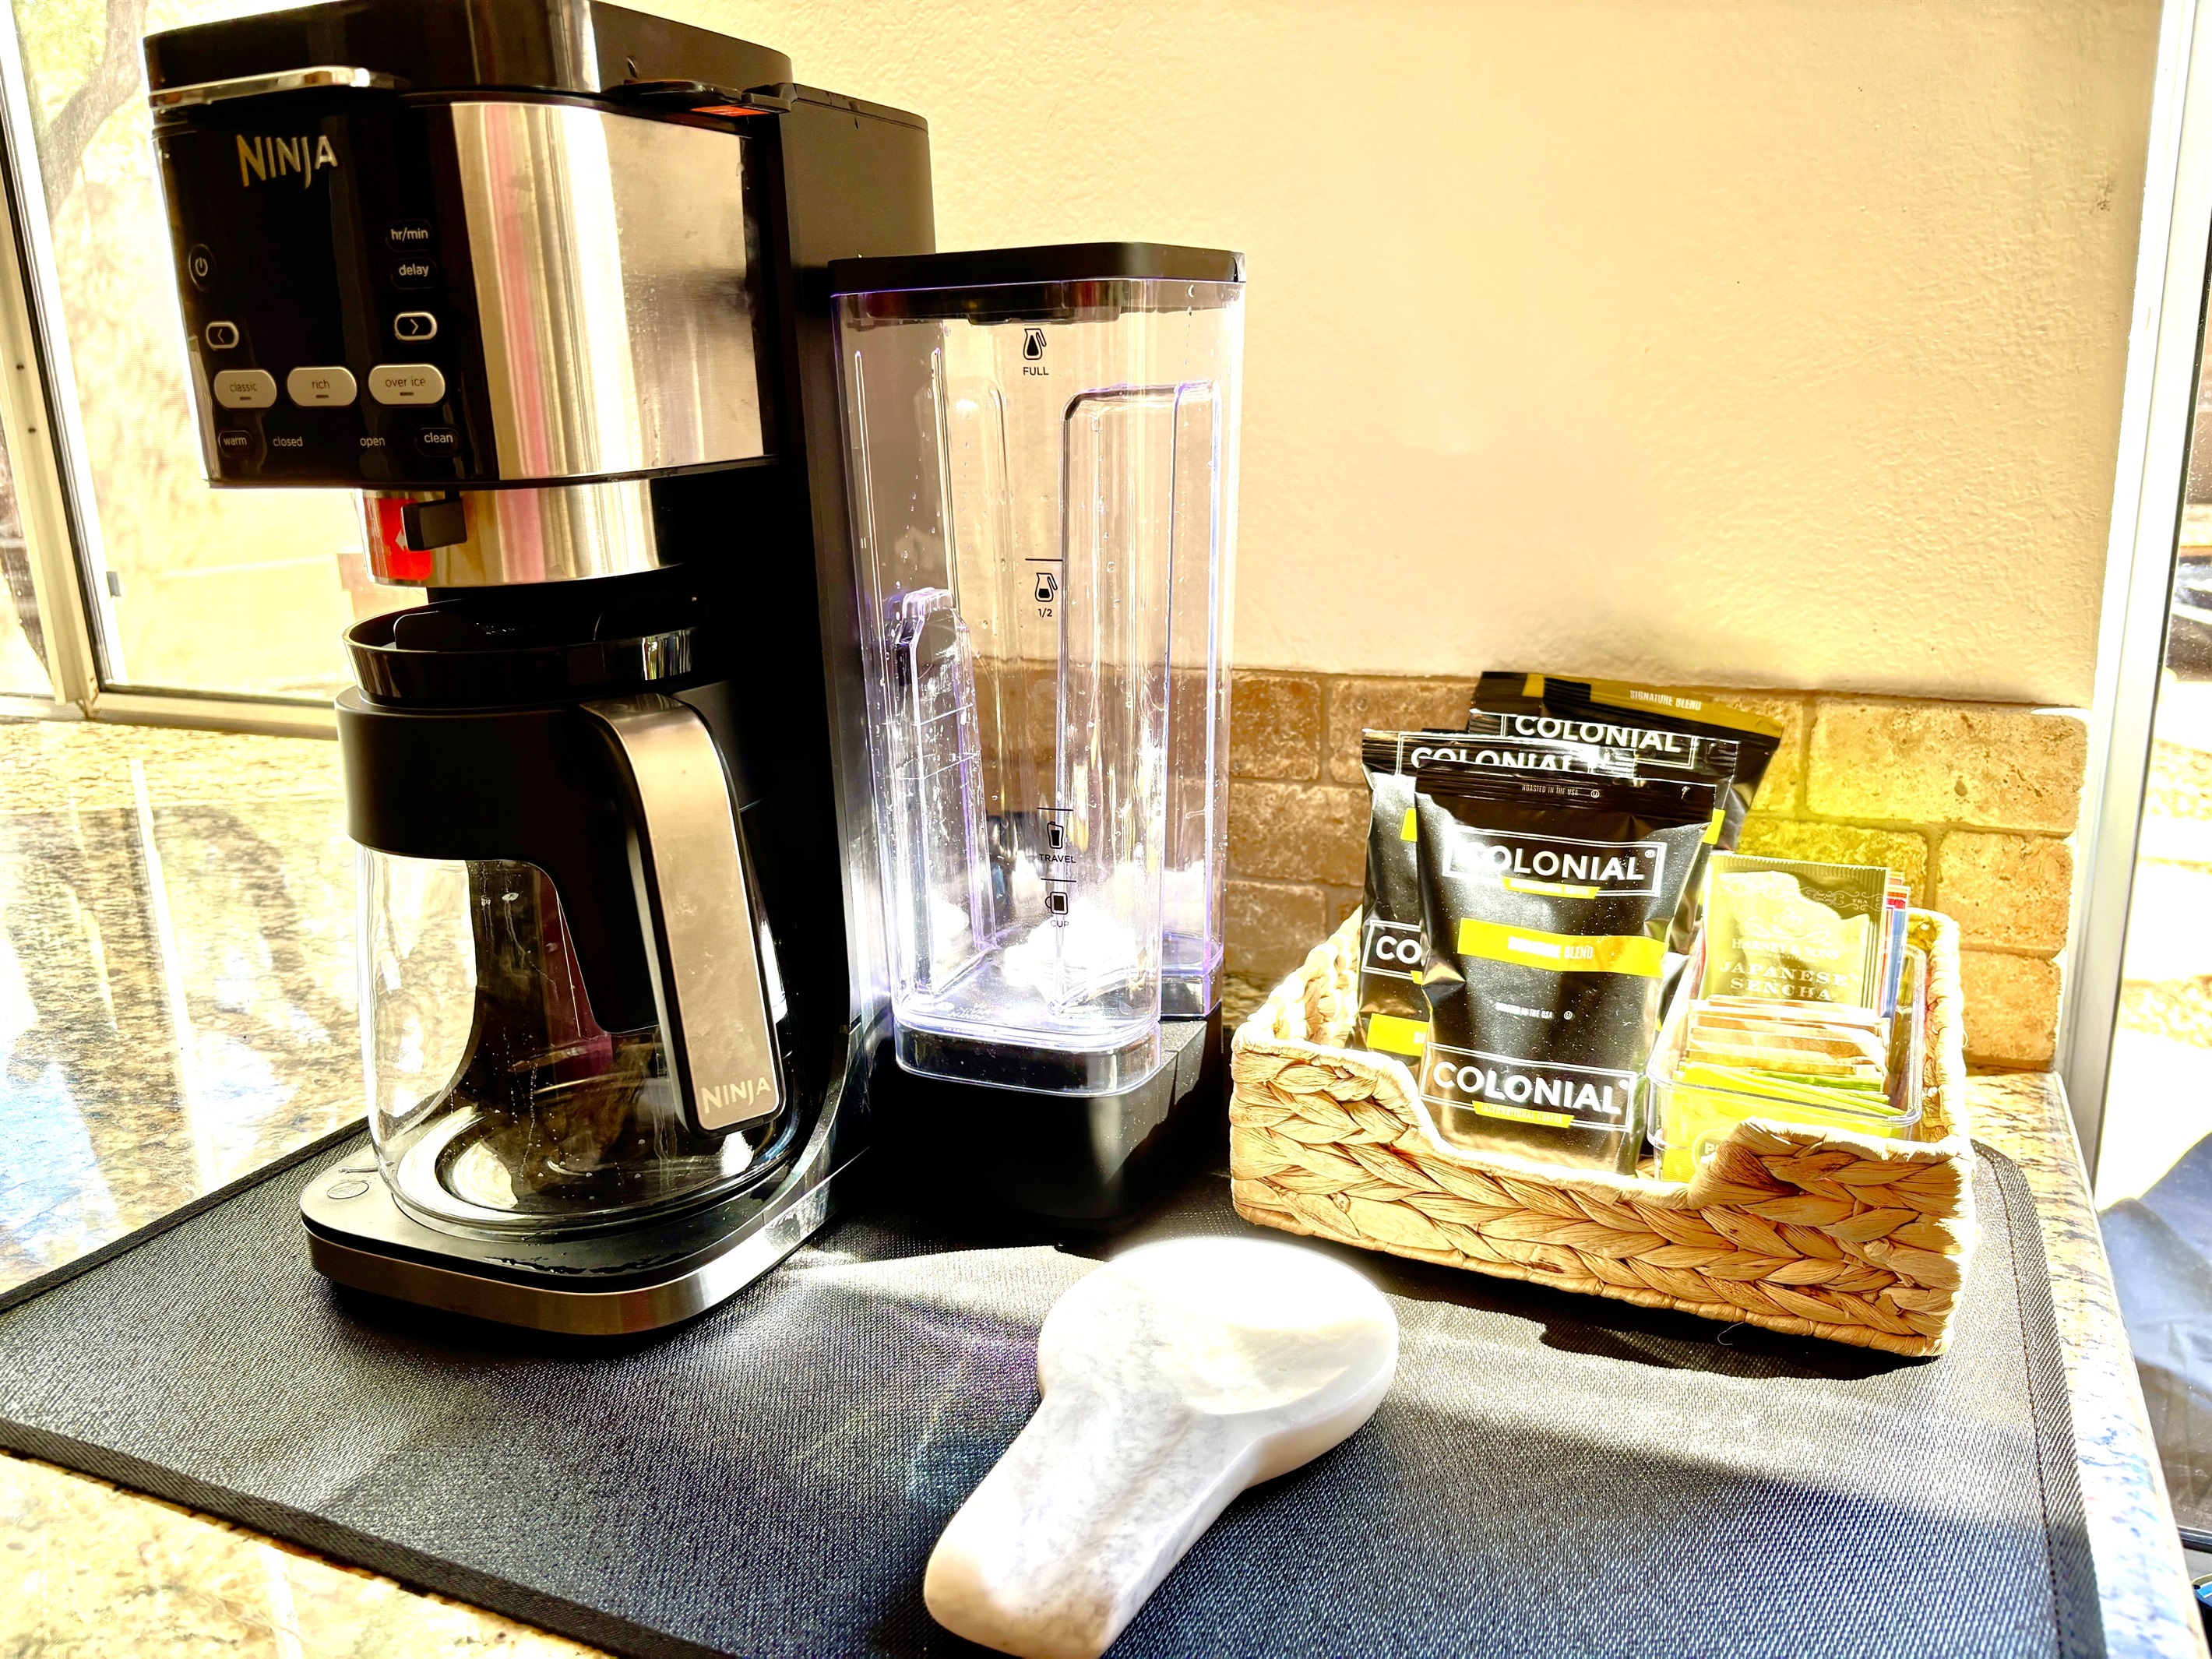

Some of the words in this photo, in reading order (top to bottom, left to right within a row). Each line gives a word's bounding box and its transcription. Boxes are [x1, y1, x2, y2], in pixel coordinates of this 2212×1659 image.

[236, 135, 338, 189] NINJA
[391, 227, 428, 242] hr/min
[399, 263, 429, 277] delay
[1023, 366, 1049, 376] FULL
[229, 381, 258, 393] classic
[312, 378, 330, 390] rich
[385, 379, 407, 388] over
[410, 376, 427, 387] ice
[224, 435, 248, 446] warm
[273, 435, 303, 448] closed
[360, 436, 386, 450] open
[424, 431, 453, 445] clean
[1037, 608, 1053, 618] 1/2
[1629, 690, 1673, 706] SIGNATURE
[1675, 697, 1703, 711] BLEND
[1515, 715, 1682, 754] COLONIAL
[1039, 854, 1076, 864] TRAVEL
[1050, 919, 1069, 928] CUP
[1564, 945, 1594, 960] BLEND
[1719, 960, 1848, 987] JAPANESE
[1730, 977, 1833, 1002] SENCHA
[1433, 1061, 1622, 1115] COLONIAL
[701, 1076, 772, 1115] NINJA
